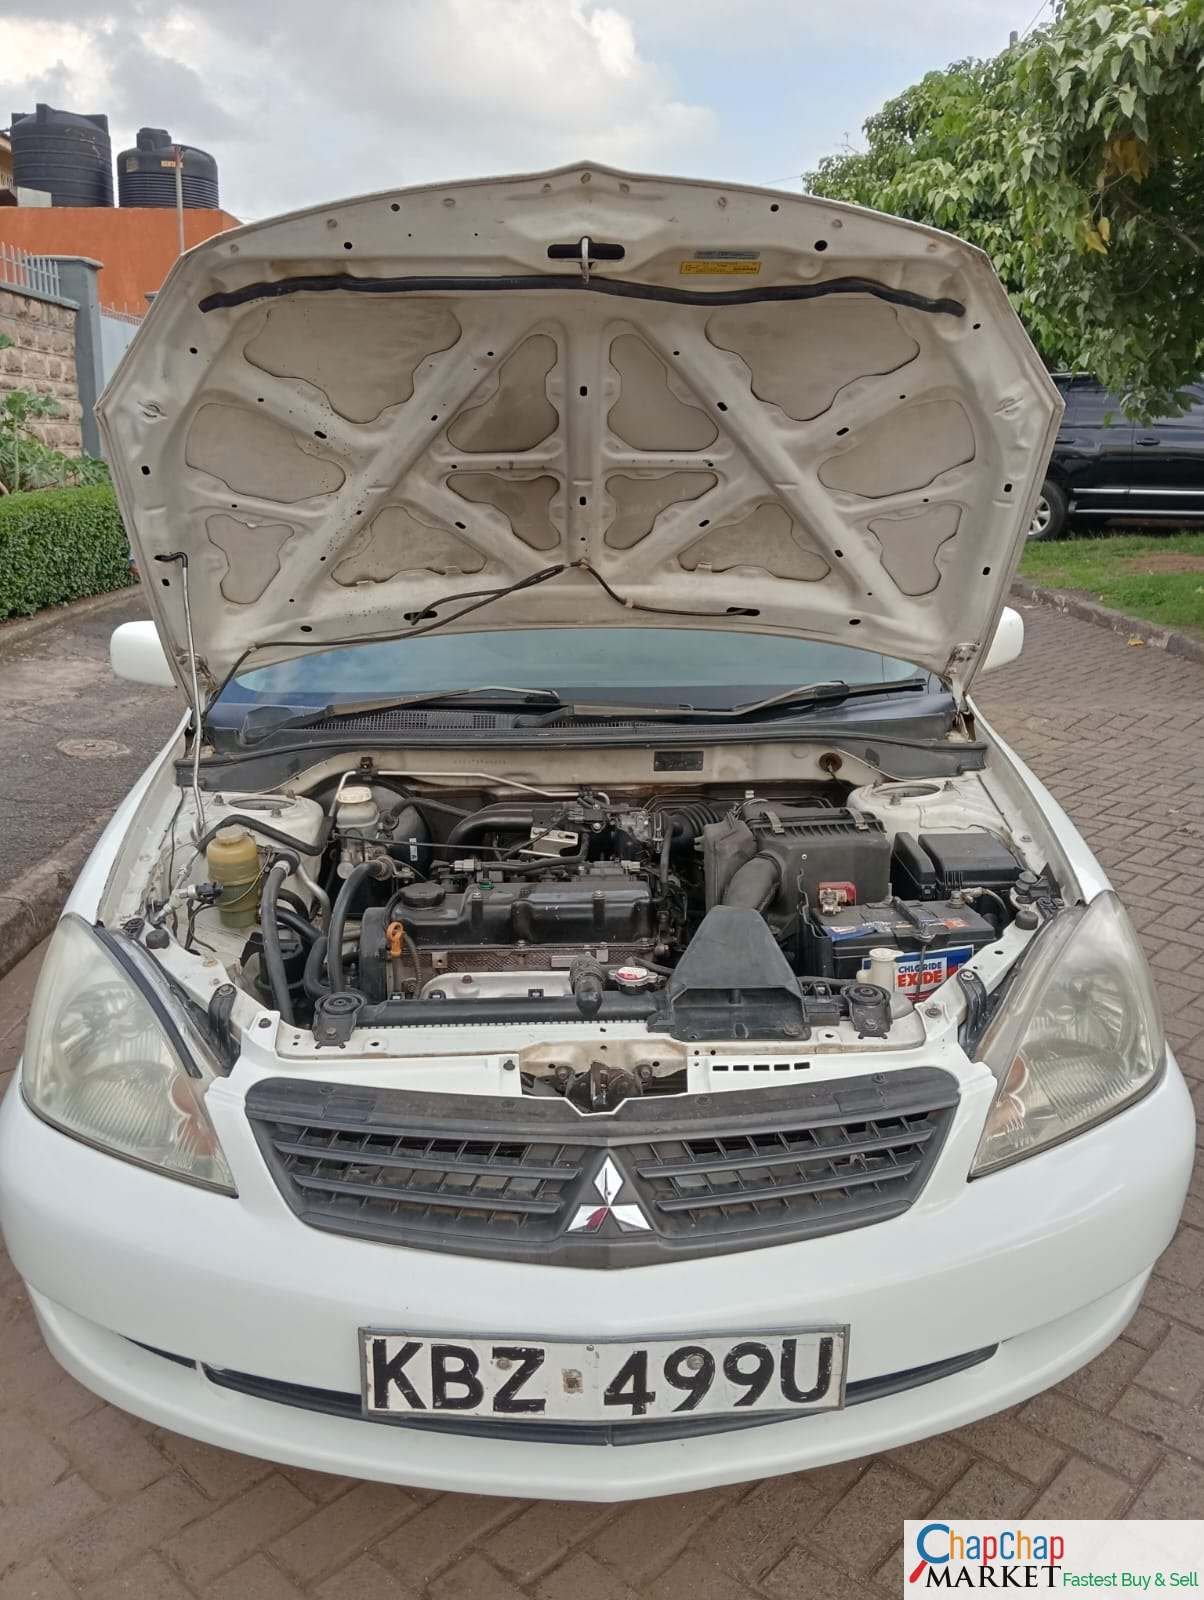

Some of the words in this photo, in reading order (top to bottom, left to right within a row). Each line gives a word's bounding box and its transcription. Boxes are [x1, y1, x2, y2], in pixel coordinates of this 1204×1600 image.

[897, 970, 942, 988] EXDE
[373, 1339, 547, 1413] KBZ
[603, 1337, 833, 1415] 499U
